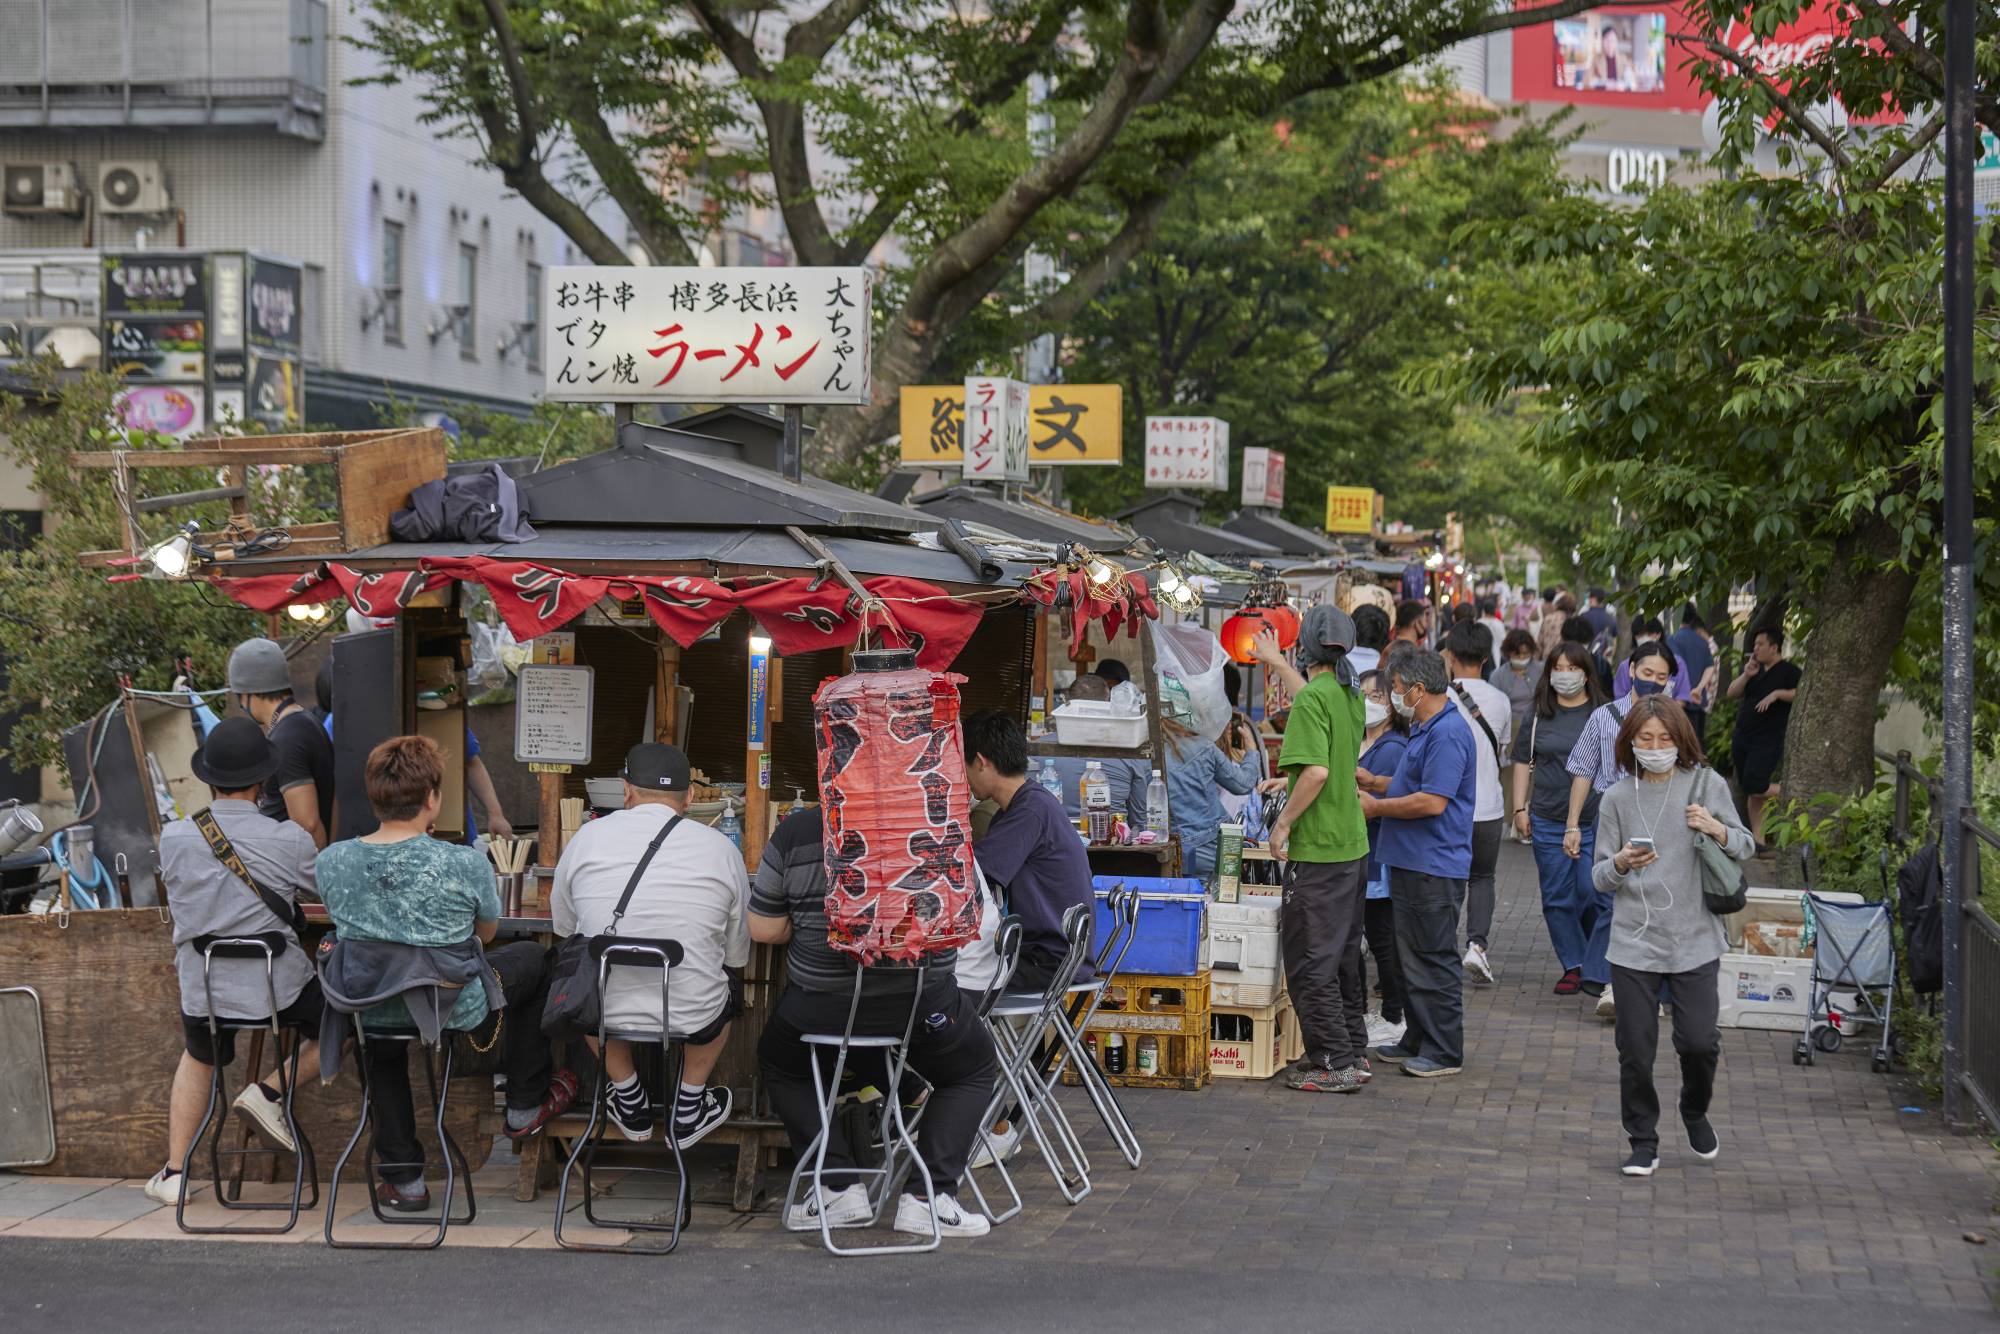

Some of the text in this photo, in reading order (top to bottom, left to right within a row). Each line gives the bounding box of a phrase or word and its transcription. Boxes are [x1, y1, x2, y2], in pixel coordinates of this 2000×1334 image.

[556, 282, 583, 384] おでん
[583, 281, 609, 384] 牛タン
[669, 281, 798, 313] 博多長浜
[823, 276, 856, 392] 大ちゃん
[647, 322, 820, 387] ラーメン
[974, 382, 997, 482] ラーメン
[1210, 1047, 1239, 1059] Asahi
[1235, 1060, 1245, 1069] 20
